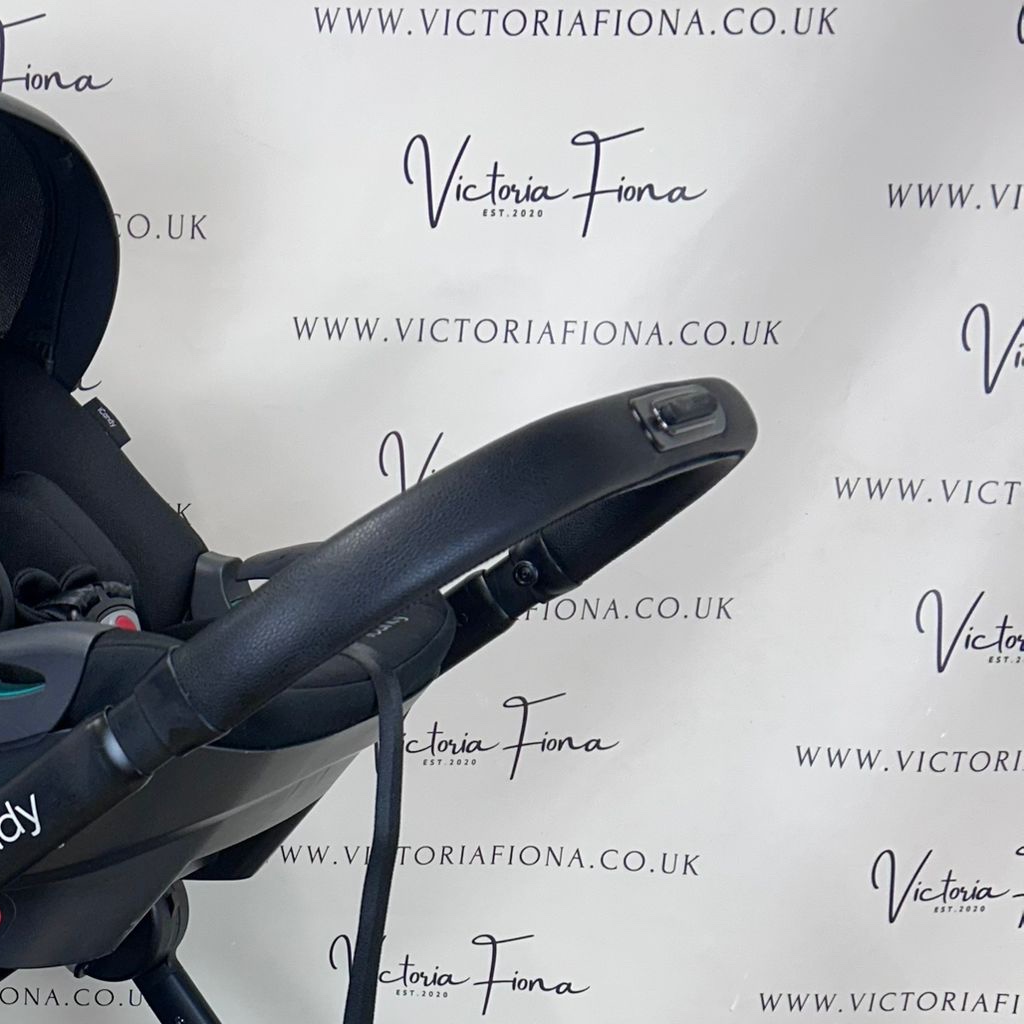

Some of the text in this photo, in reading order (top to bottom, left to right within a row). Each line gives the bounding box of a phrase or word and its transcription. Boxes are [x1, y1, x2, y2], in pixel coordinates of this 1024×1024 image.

[314, 7, 838, 36] WWW.VICTORIAFIONA.CO.UK
[403, 127, 707, 238] Victoria Fiona
[483, 209, 543, 217] EST.2020
[293, 316, 782, 346] WWW.VICTORIAFIONA.CO.UK
[502, 692, 620, 780] Fiona
[280, 845, 700, 876] WW.VITORIAFIONA.CO.UK
[871, 849, 1010, 924] Victoria
[934, 905, 985, 913] EST.2020
[471, 934, 590, 1016] Fiona
[396, 989, 448, 998] EST.2020
[760, 991, 1020, 1014] WWW.VICTORIAFI
